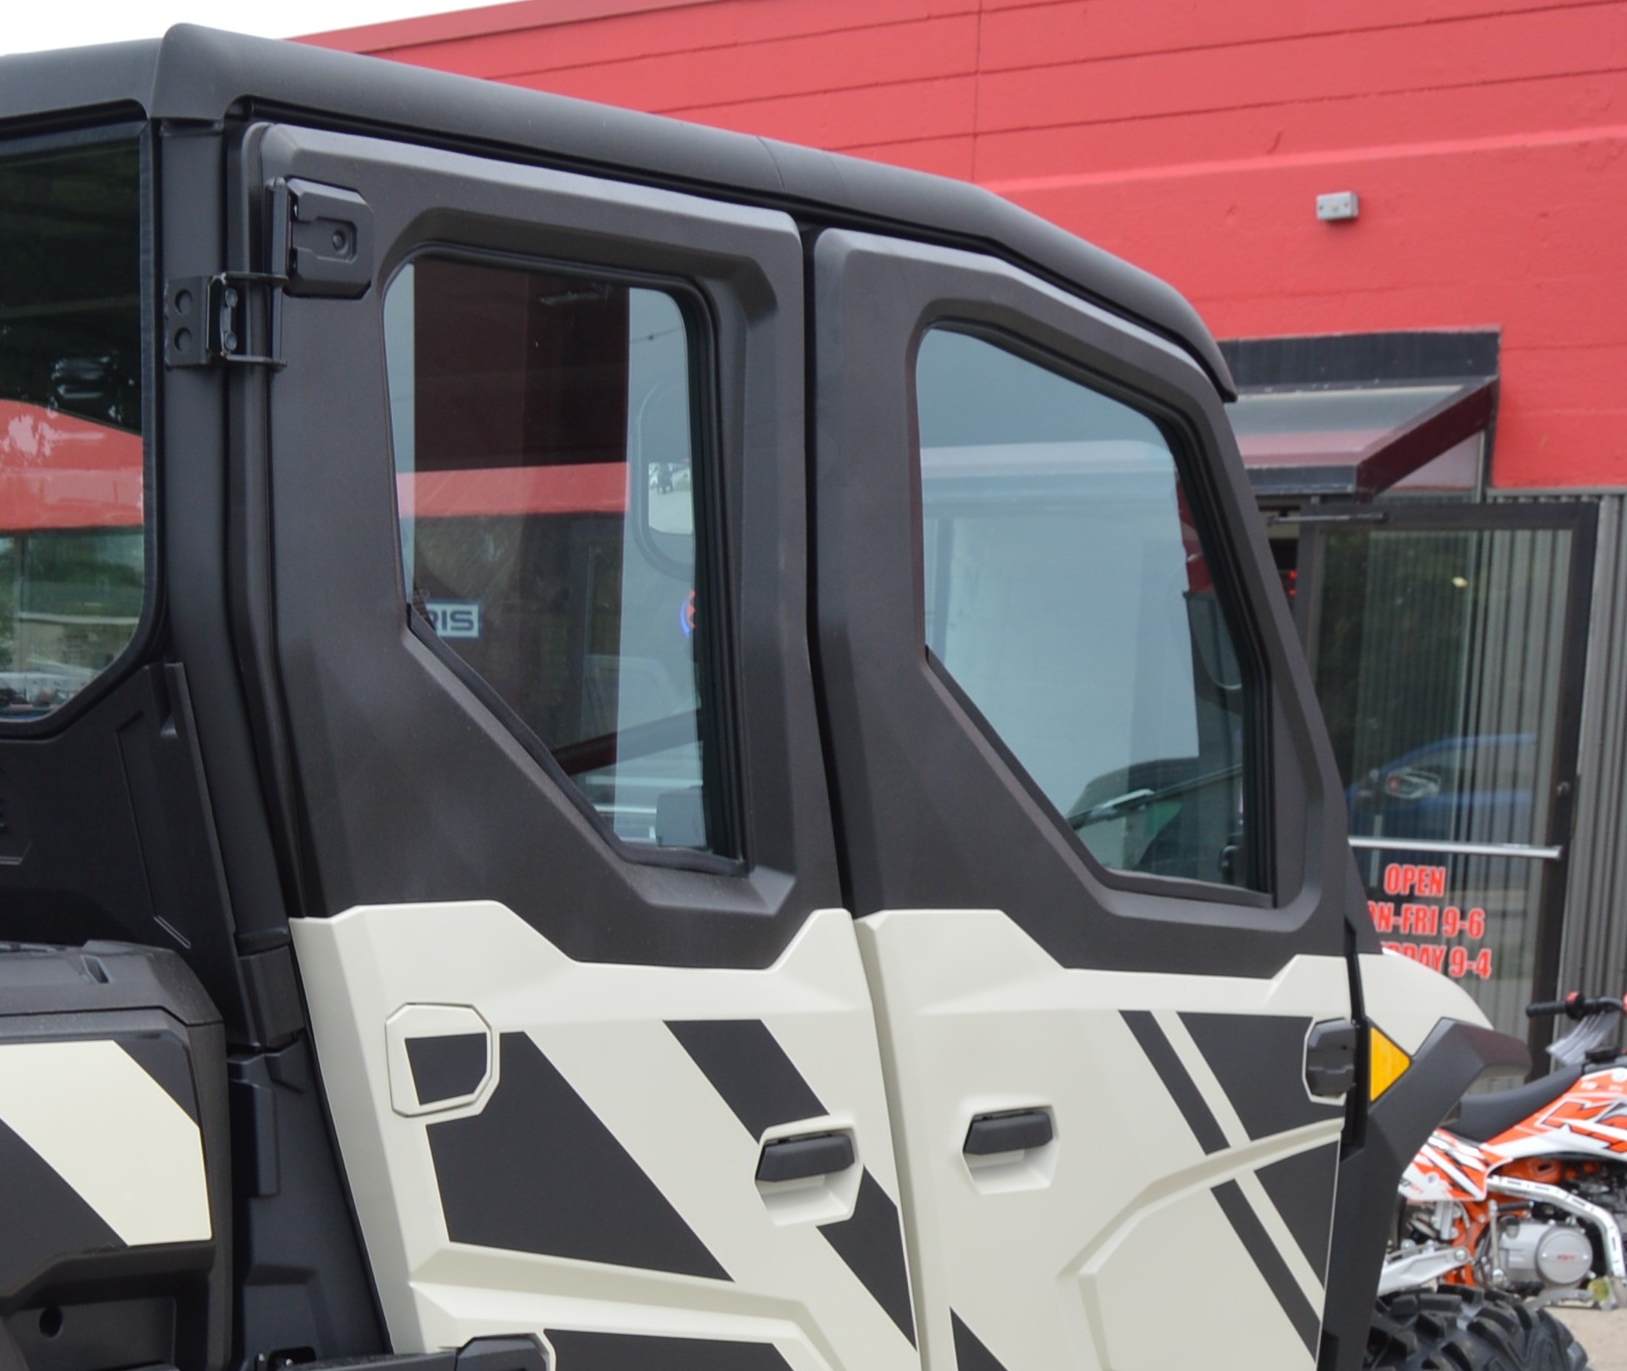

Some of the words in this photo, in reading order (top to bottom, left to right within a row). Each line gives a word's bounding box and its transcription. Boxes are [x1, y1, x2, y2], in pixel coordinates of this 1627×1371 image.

[1384, 863, 1446, 897] OPEN
[1443, 906, 1486, 940] 9-6
[1449, 946, 1492, 979] 9-4
